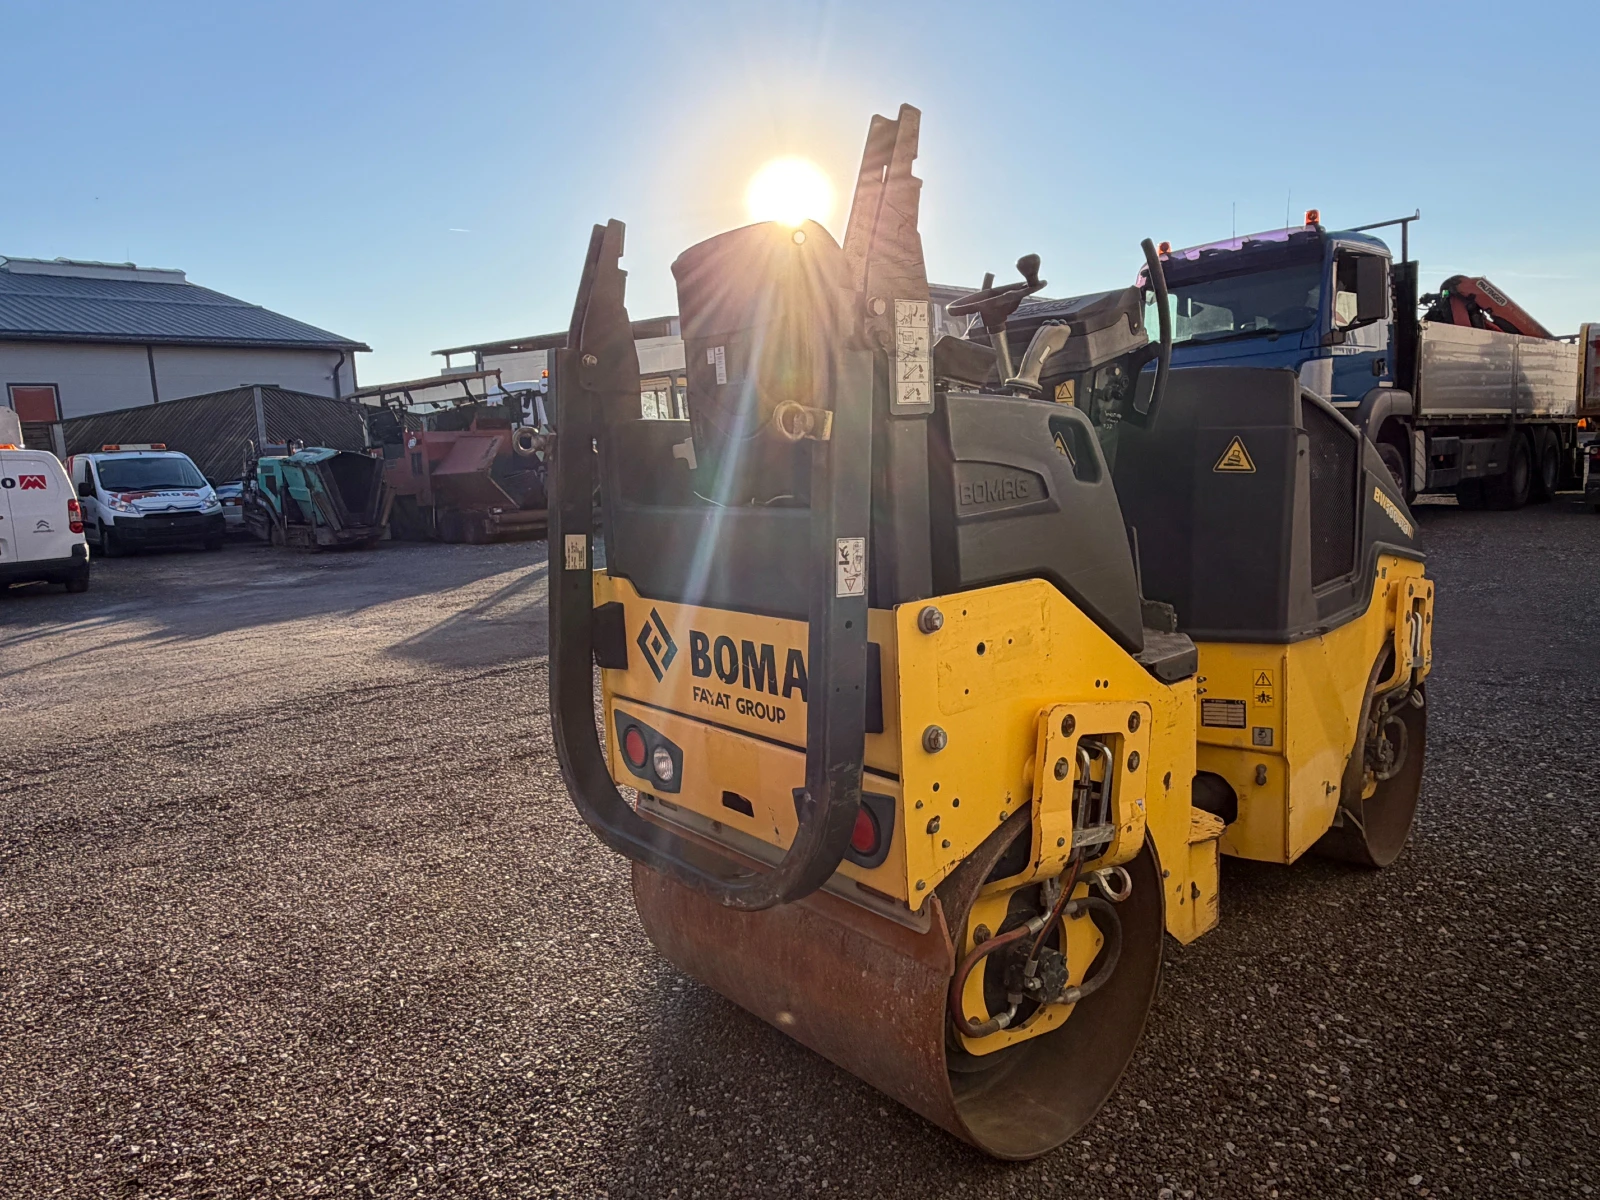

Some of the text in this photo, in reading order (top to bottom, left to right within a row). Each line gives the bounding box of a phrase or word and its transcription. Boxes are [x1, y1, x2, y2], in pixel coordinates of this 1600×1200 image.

[1477, 280, 1506, 305] PALFINGER
[0, 477, 16, 489] O
[959, 478, 1029, 506] BOMAG
[689, 629, 808, 703] BOMA
[692, 686, 786, 724] FAYAT GROUP
